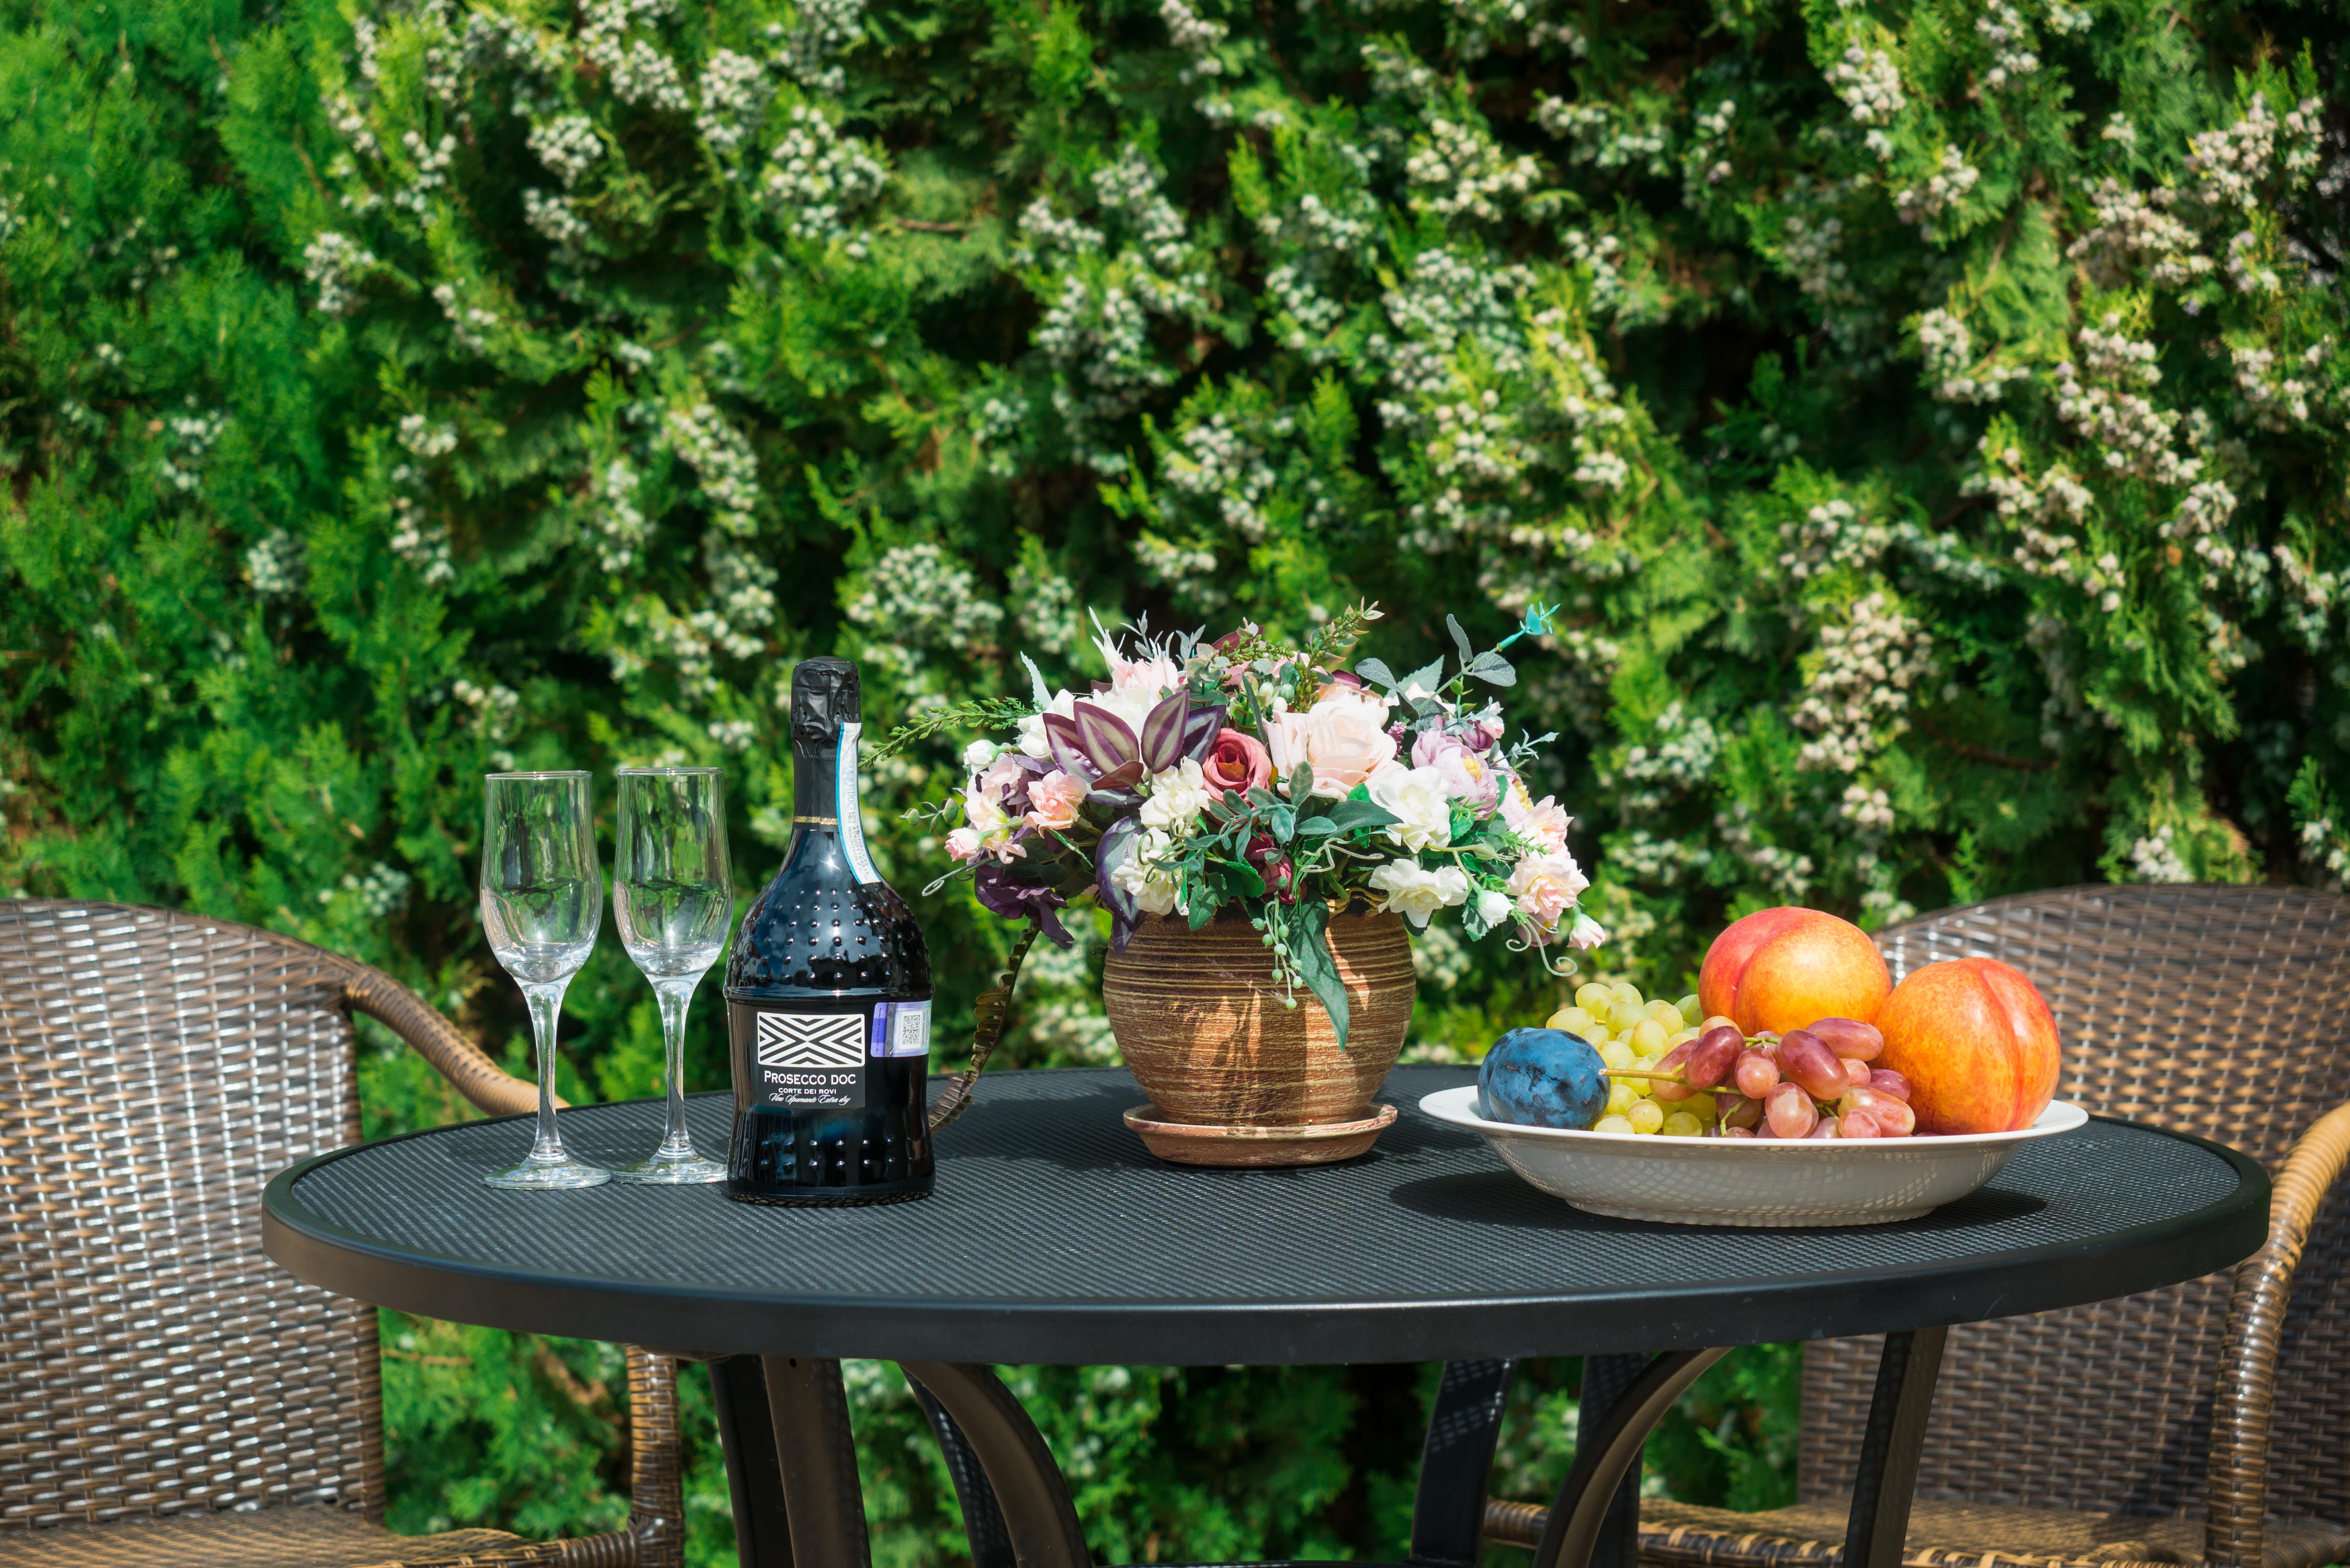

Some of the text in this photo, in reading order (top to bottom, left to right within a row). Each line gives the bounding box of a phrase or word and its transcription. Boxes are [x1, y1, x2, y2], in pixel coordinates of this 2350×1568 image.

[764, 1070, 856, 1085] PROSECCO DOC
[769, 1093, 851, 1106] Vino Spumante Extra dry
